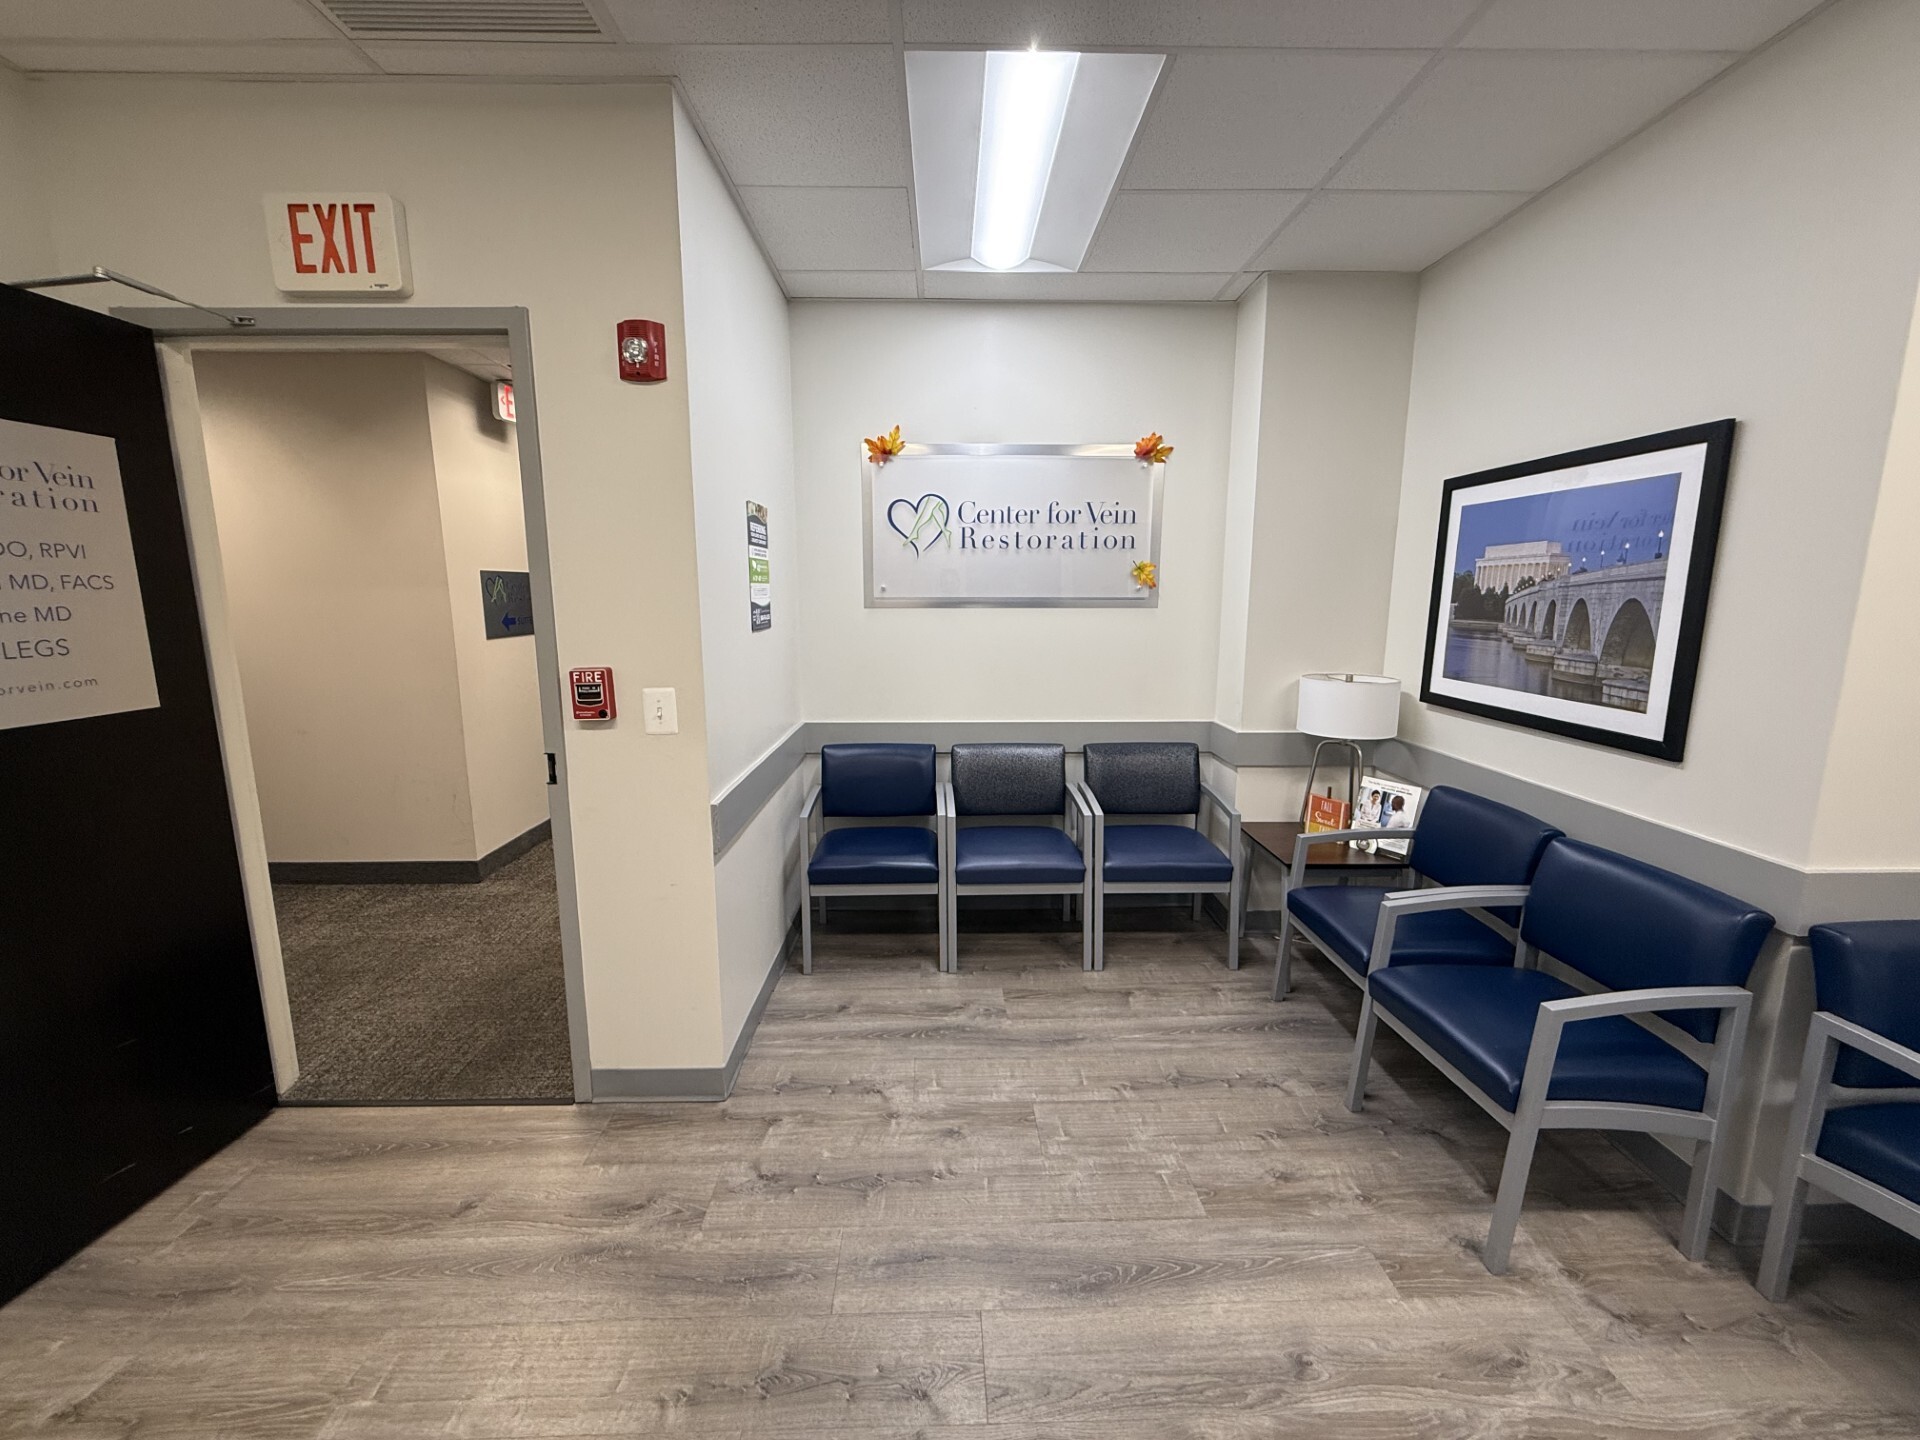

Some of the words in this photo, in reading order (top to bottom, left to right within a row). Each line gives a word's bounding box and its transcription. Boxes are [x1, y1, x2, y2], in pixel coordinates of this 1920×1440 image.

[287, 203, 376, 274] EXIT
[33, 461, 95, 490] Vein
[0, 487, 100, 513] ation
[957, 500, 1040, 525] Center
[1047, 501, 1082, 525] for
[1084, 501, 1136, 525] Vein
[959, 526, 1136, 550] Restoration
[39, 542, 86, 559] RPVI
[9, 574, 54, 592] MD,
[60, 574, 114, 590] FACS
[34, 606, 72, 622] MD
[2, 638, 70, 660] LEGS
[573, 671, 602, 683] FIRE
